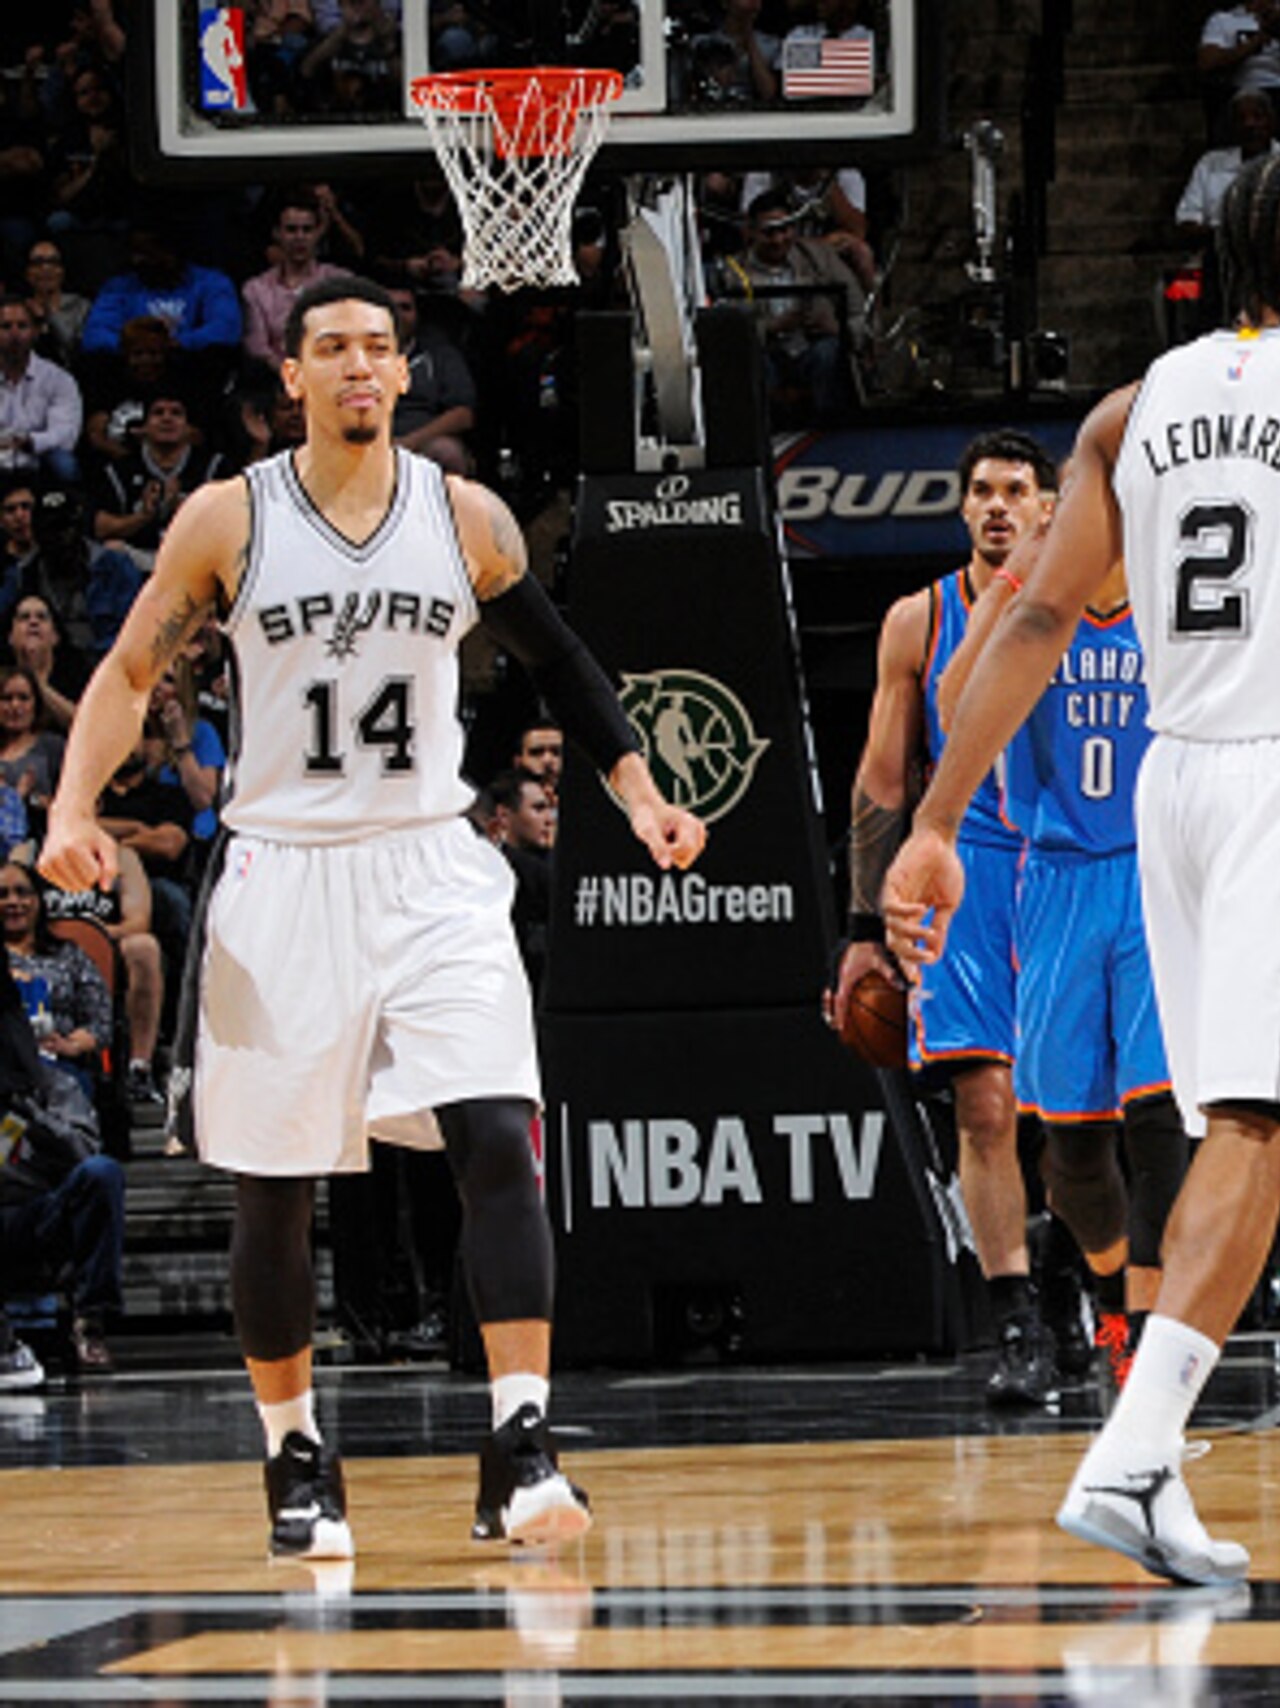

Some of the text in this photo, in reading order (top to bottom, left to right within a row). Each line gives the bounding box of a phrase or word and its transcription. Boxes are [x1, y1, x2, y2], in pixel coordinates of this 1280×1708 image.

[606, 493, 741, 532] SPALDING
[1169, 498, 1256, 641] 2
[258, 588, 455, 661] SPURS
[302, 674, 417, 778] 14
[1066, 690, 1135, 727] CITY
[1081, 736, 1114, 799] 0
[575, 873, 793, 926] #NBAGreen
[588, 1111, 885, 1208] NBA TV
